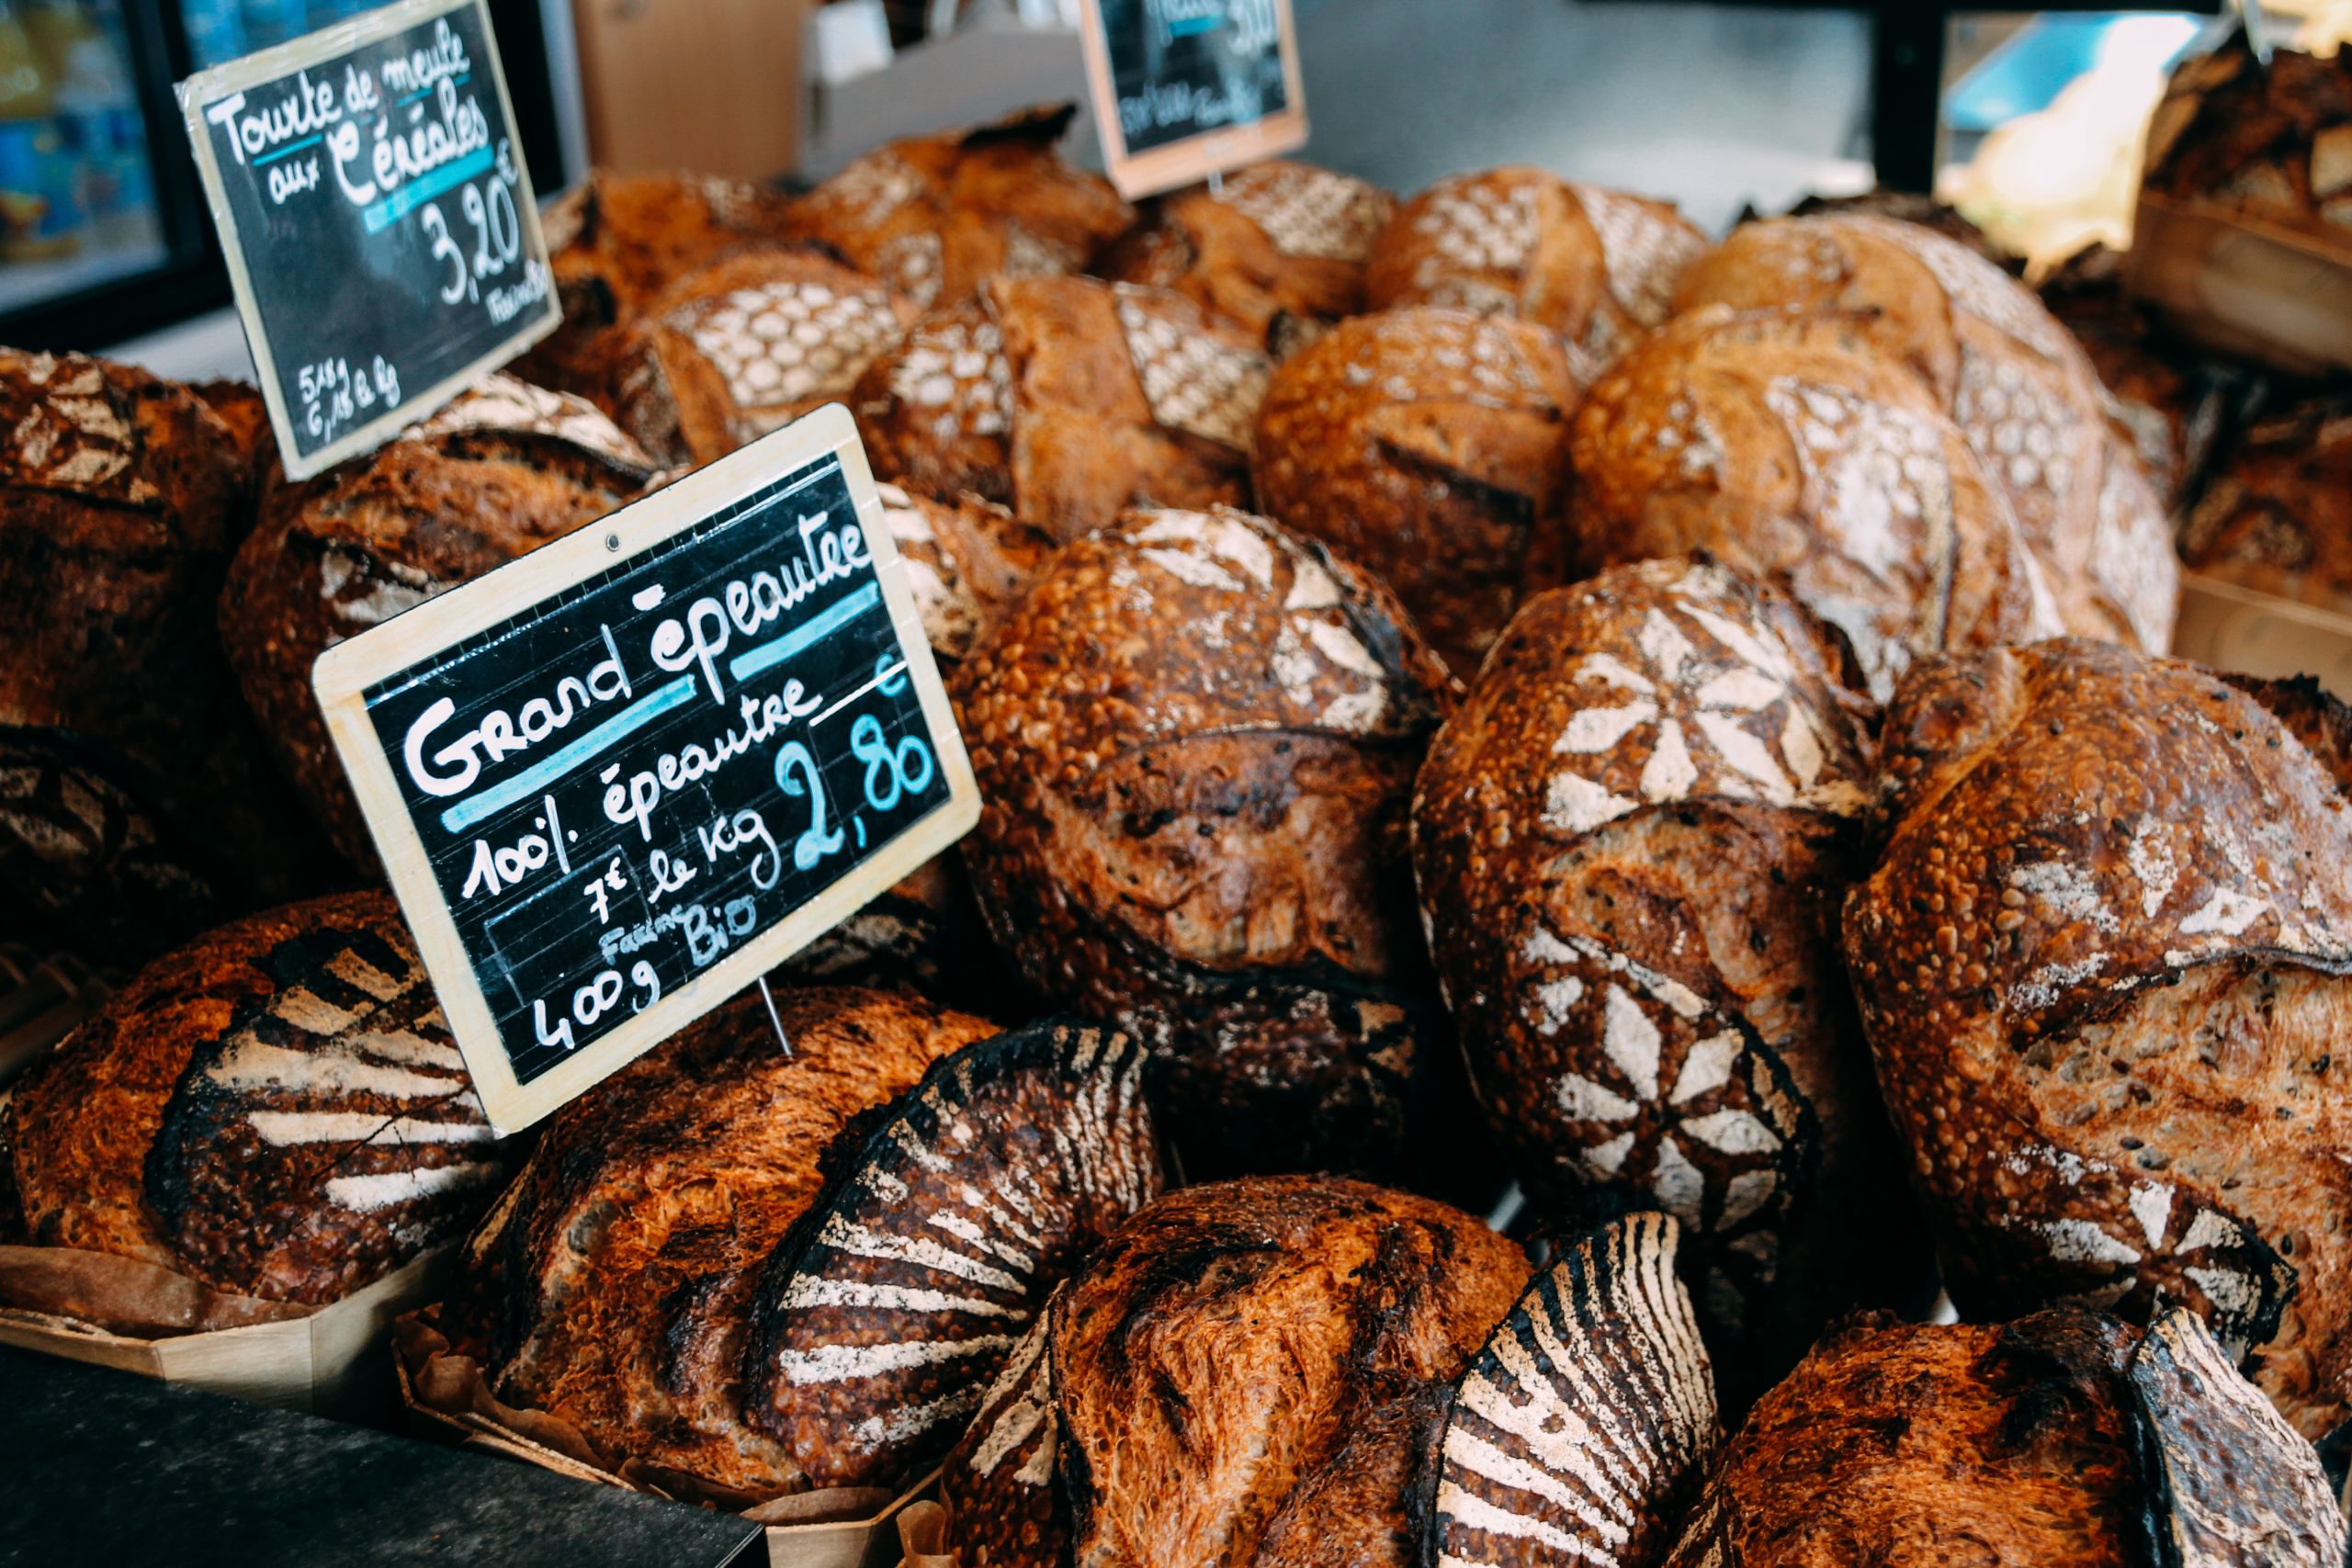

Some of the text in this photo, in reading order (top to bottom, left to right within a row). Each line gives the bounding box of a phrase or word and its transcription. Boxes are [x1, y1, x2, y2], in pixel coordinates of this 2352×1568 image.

[345, 63, 379, 112] de
[382, 17, 470, 90] meule
[268, 75, 489, 206] aux Céréales
[404, 511, 875, 797] Grand épeautre
[462, 678, 824, 898] 100% épeautre
[648, 849, 698, 904] le
